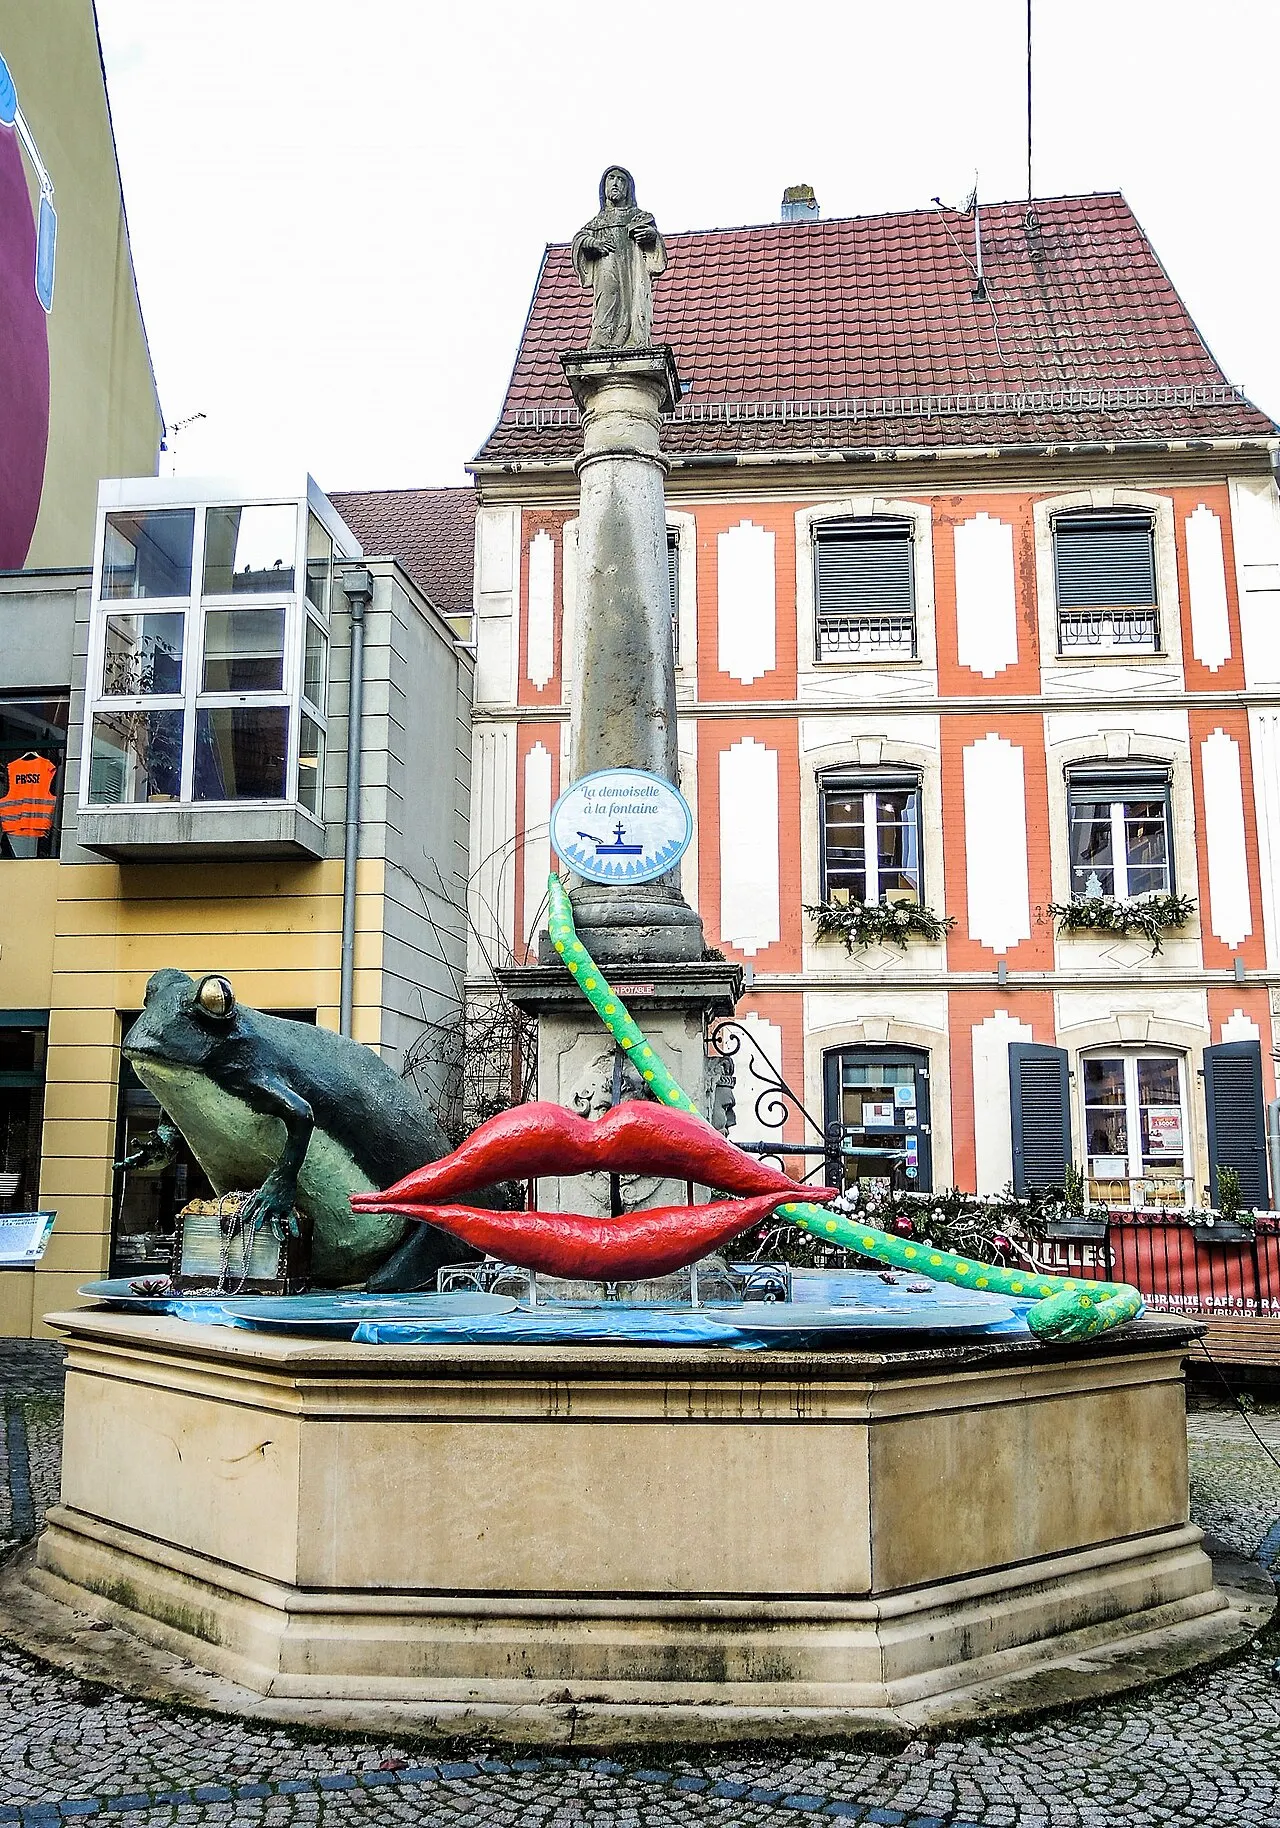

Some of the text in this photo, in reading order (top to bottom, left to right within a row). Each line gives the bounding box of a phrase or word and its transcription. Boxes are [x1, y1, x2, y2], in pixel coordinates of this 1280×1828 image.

[582, 786, 660, 800] La demoiselle
[584, 802, 659, 817] à la fontaine
[620, 986, 652, 994] POTABLE
